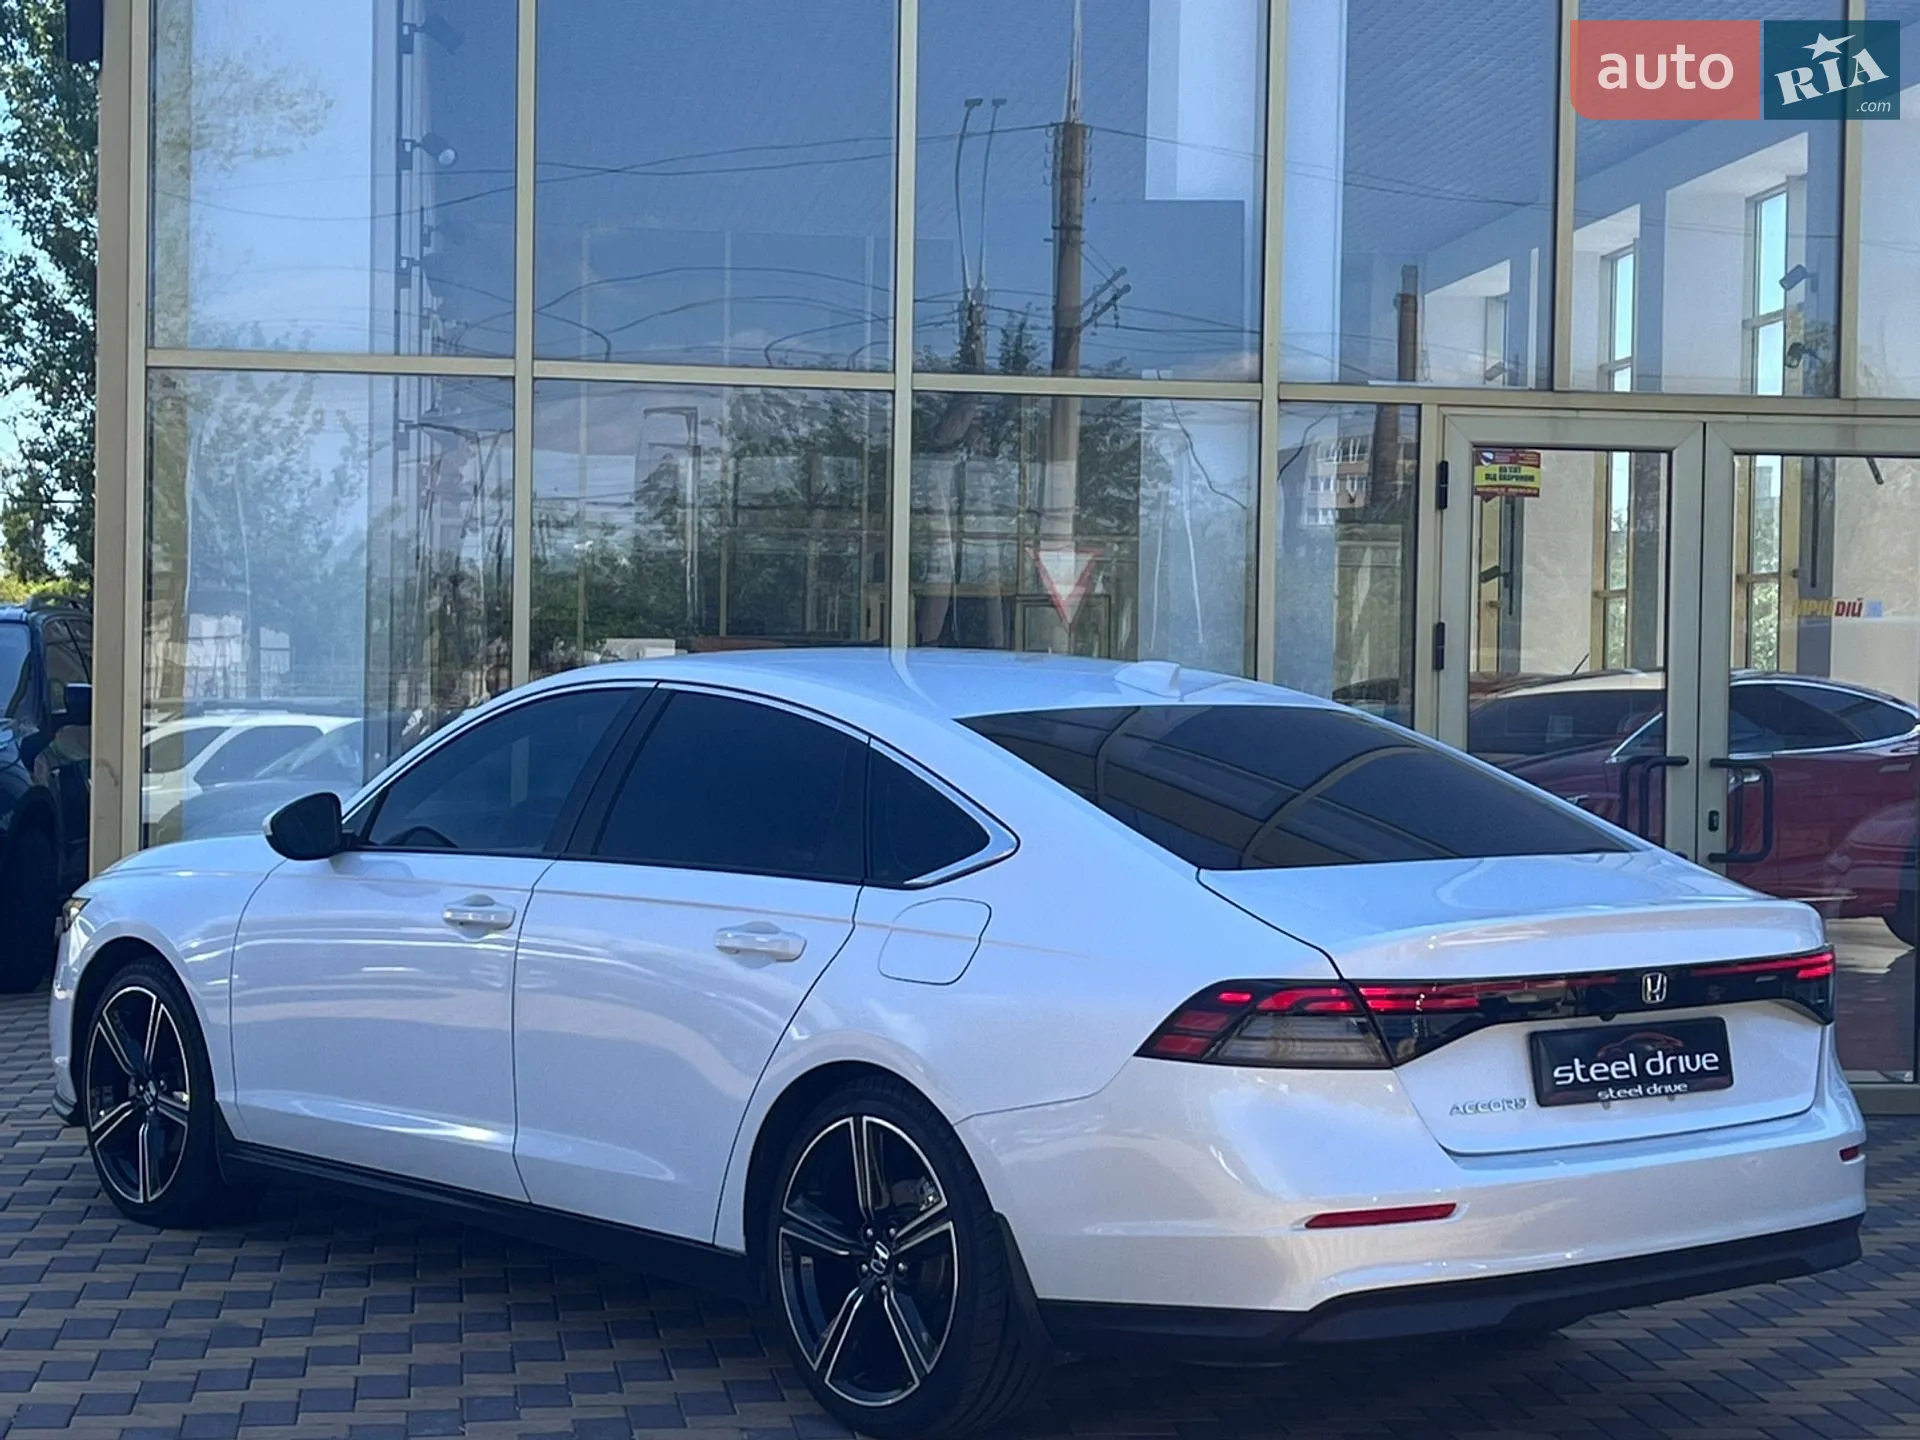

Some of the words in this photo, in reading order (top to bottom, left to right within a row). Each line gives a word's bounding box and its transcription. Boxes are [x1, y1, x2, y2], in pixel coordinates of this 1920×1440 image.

[1553, 1053, 1639, 1085] steel
[1645, 1050, 1720, 1076] drive
[1597, 1084, 1643, 1100] steel
[1646, 1082, 1688, 1096] drive
[1449, 1097, 1528, 1116] ACCORD
